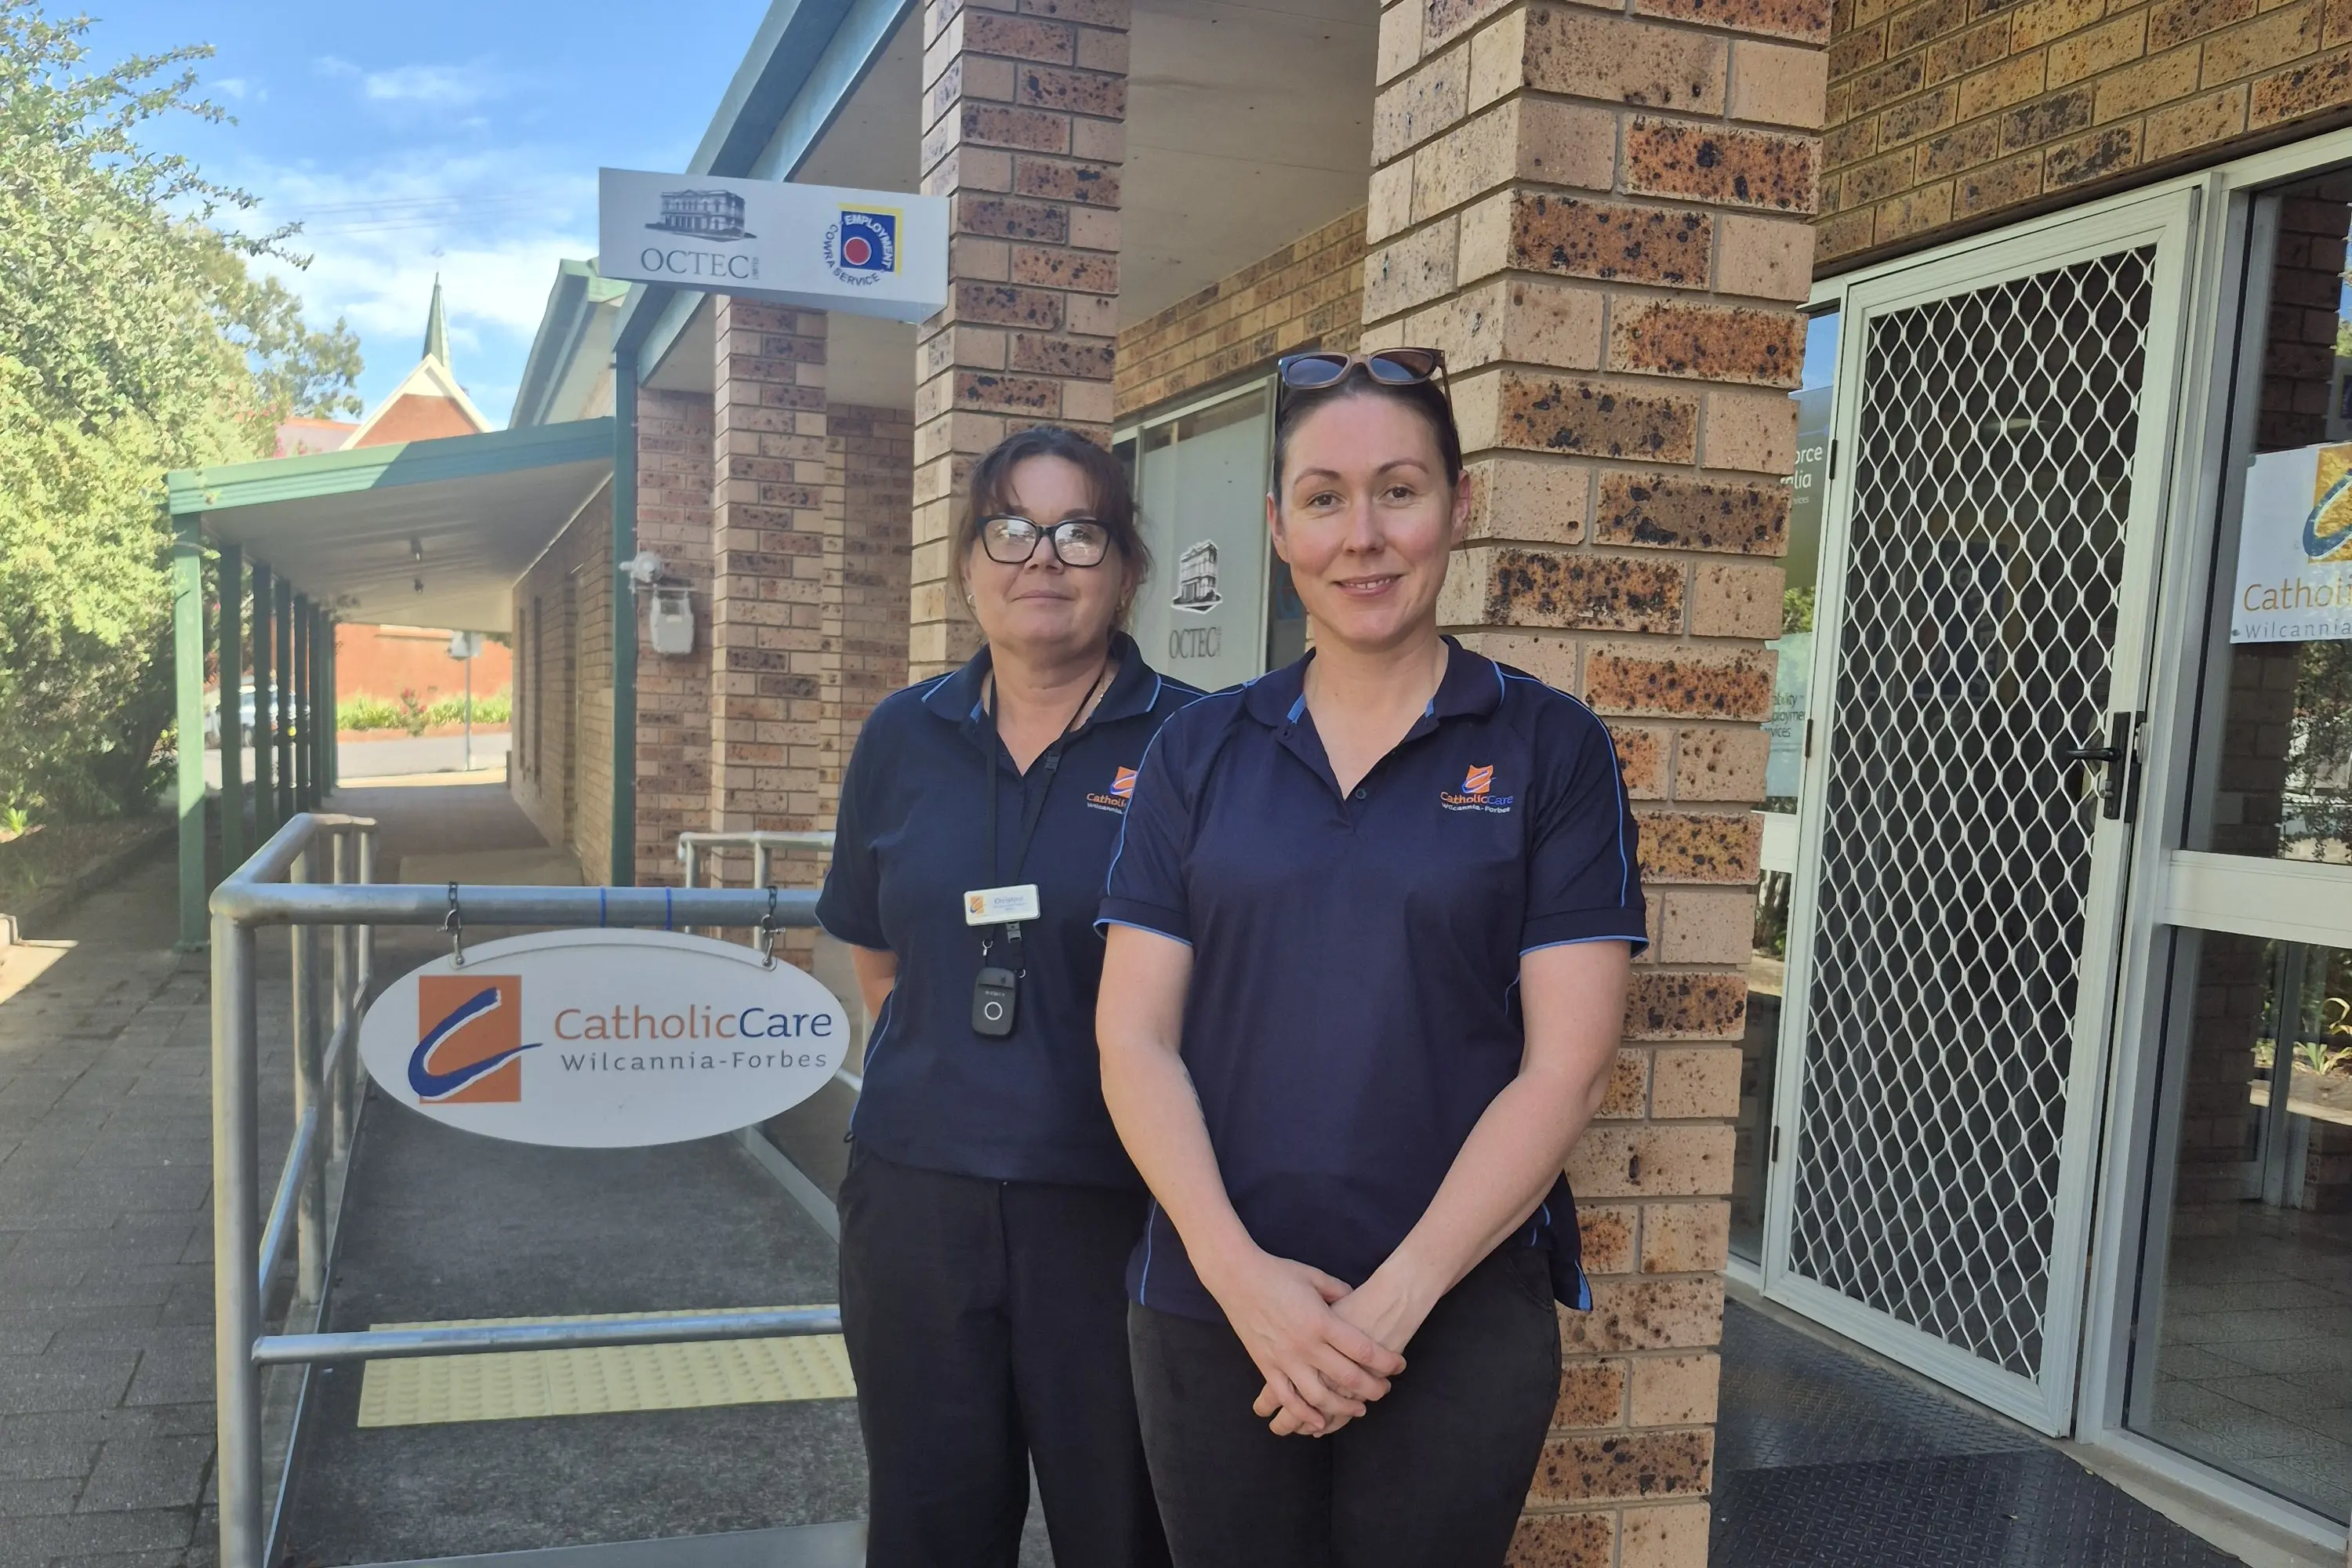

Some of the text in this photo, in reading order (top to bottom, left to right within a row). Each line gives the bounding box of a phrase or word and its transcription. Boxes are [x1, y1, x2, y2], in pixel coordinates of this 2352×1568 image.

[844, 214, 894, 269] EMPLOYMENT
[641, 248, 750, 279] OCTEC
[822, 223, 880, 286] COWRA SERVICE
[1794, 445, 1824, 465] orce
[1169, 626, 1217, 659] OCTEC
[1772, 692, 1798, 709] ability
[1772, 709, 1806, 725] ployme
[1087, 793, 1127, 808] Catholi
[1439, 791, 1514, 805] CatholicCare
[1441, 801, 1511, 814] Wilcannia-Forbes
[554, 1004, 833, 1040] CatholicCare
[560, 1049, 829, 1073] Wilcannia-Forbes
